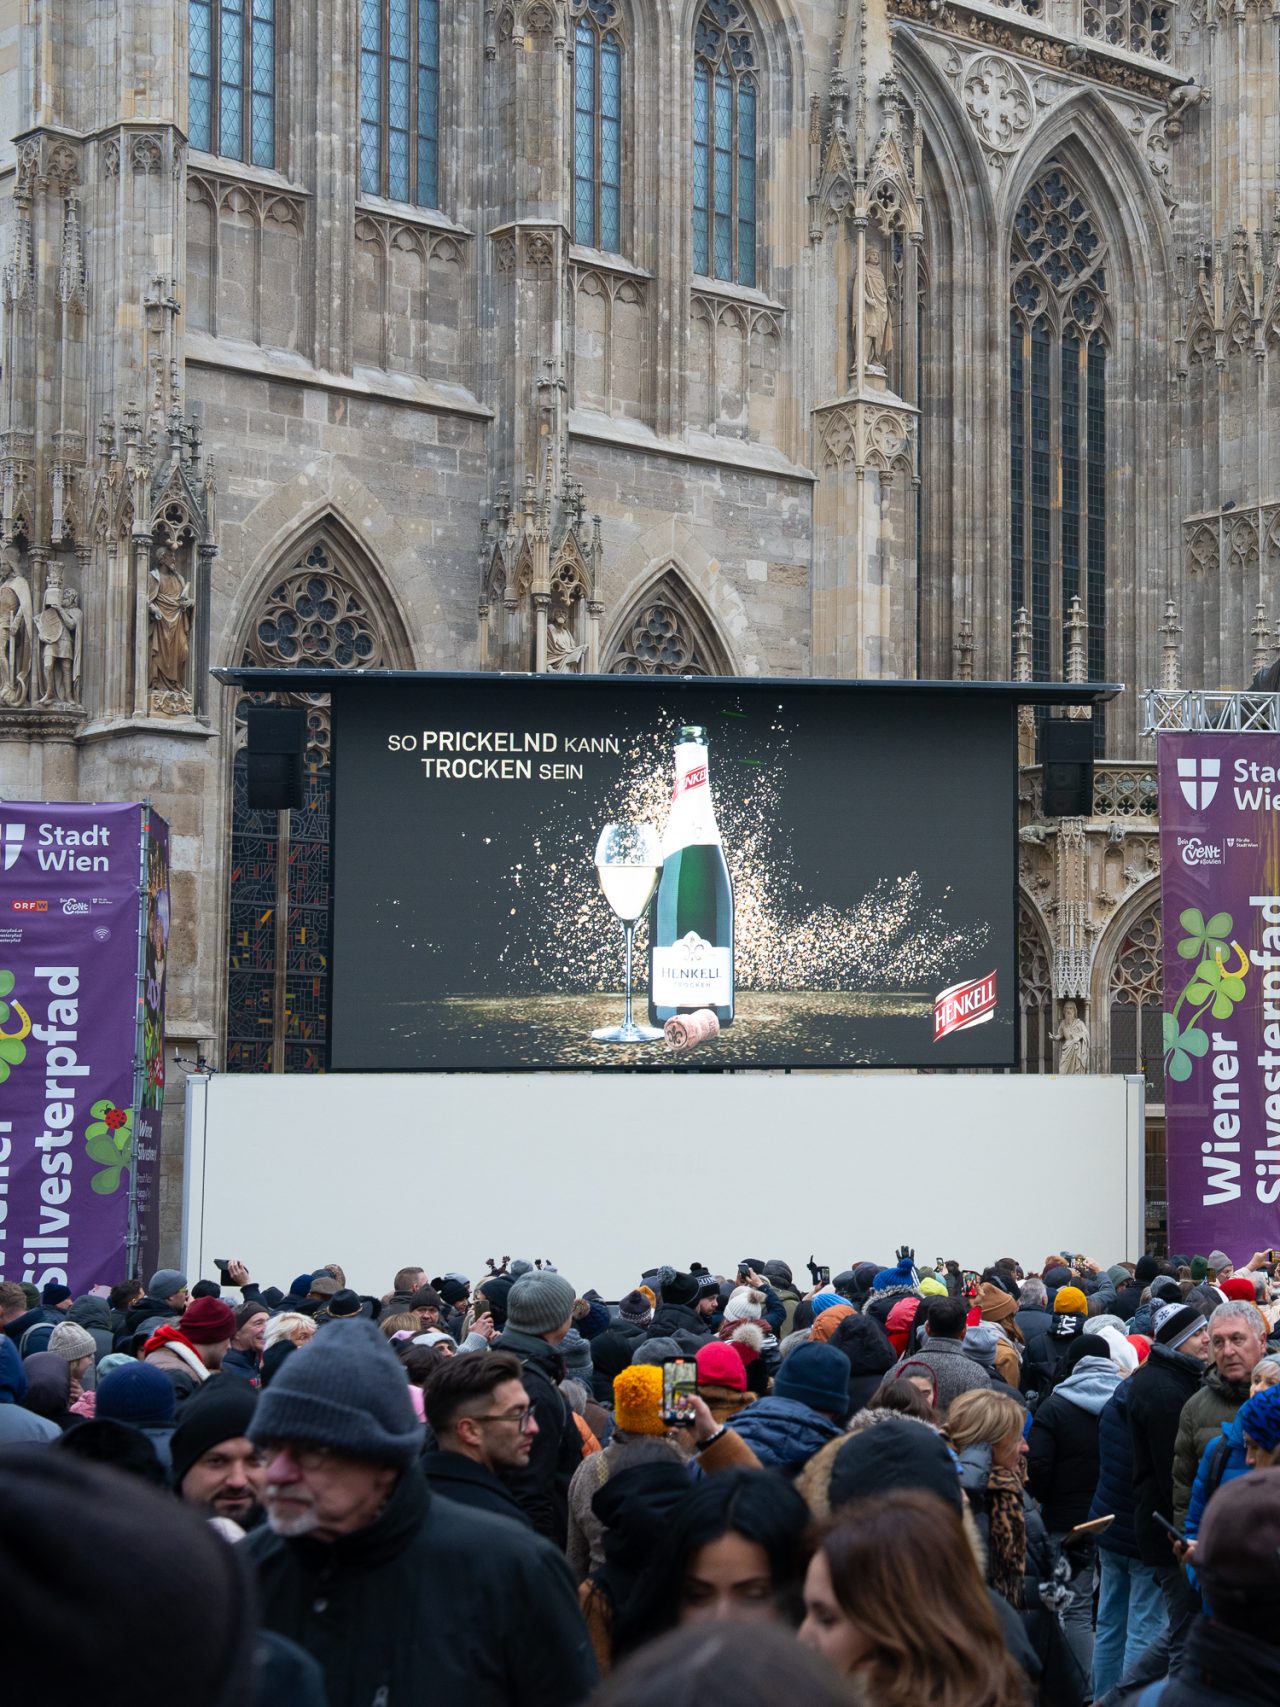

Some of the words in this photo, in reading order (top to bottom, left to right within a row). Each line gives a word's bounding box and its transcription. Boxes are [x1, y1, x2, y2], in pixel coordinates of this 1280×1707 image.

[388, 735, 417, 751] SO
[422, 731, 558, 753] PRICKELND
[564, 737, 619, 753] KANN
[421, 758, 532, 779] TROCKEN
[538, 764, 583, 780] SEIN
[38, 823, 110, 846] Stadt
[37, 849, 110, 871] Wien
[13, 902, 36, 910] ORF
[661, 967, 722, 979] HENKELL
[935, 980, 996, 1033] HENKELL
[22, 966, 90, 1293] Silvesterpfad
[1201, 1032, 1241, 1206] Wiener
